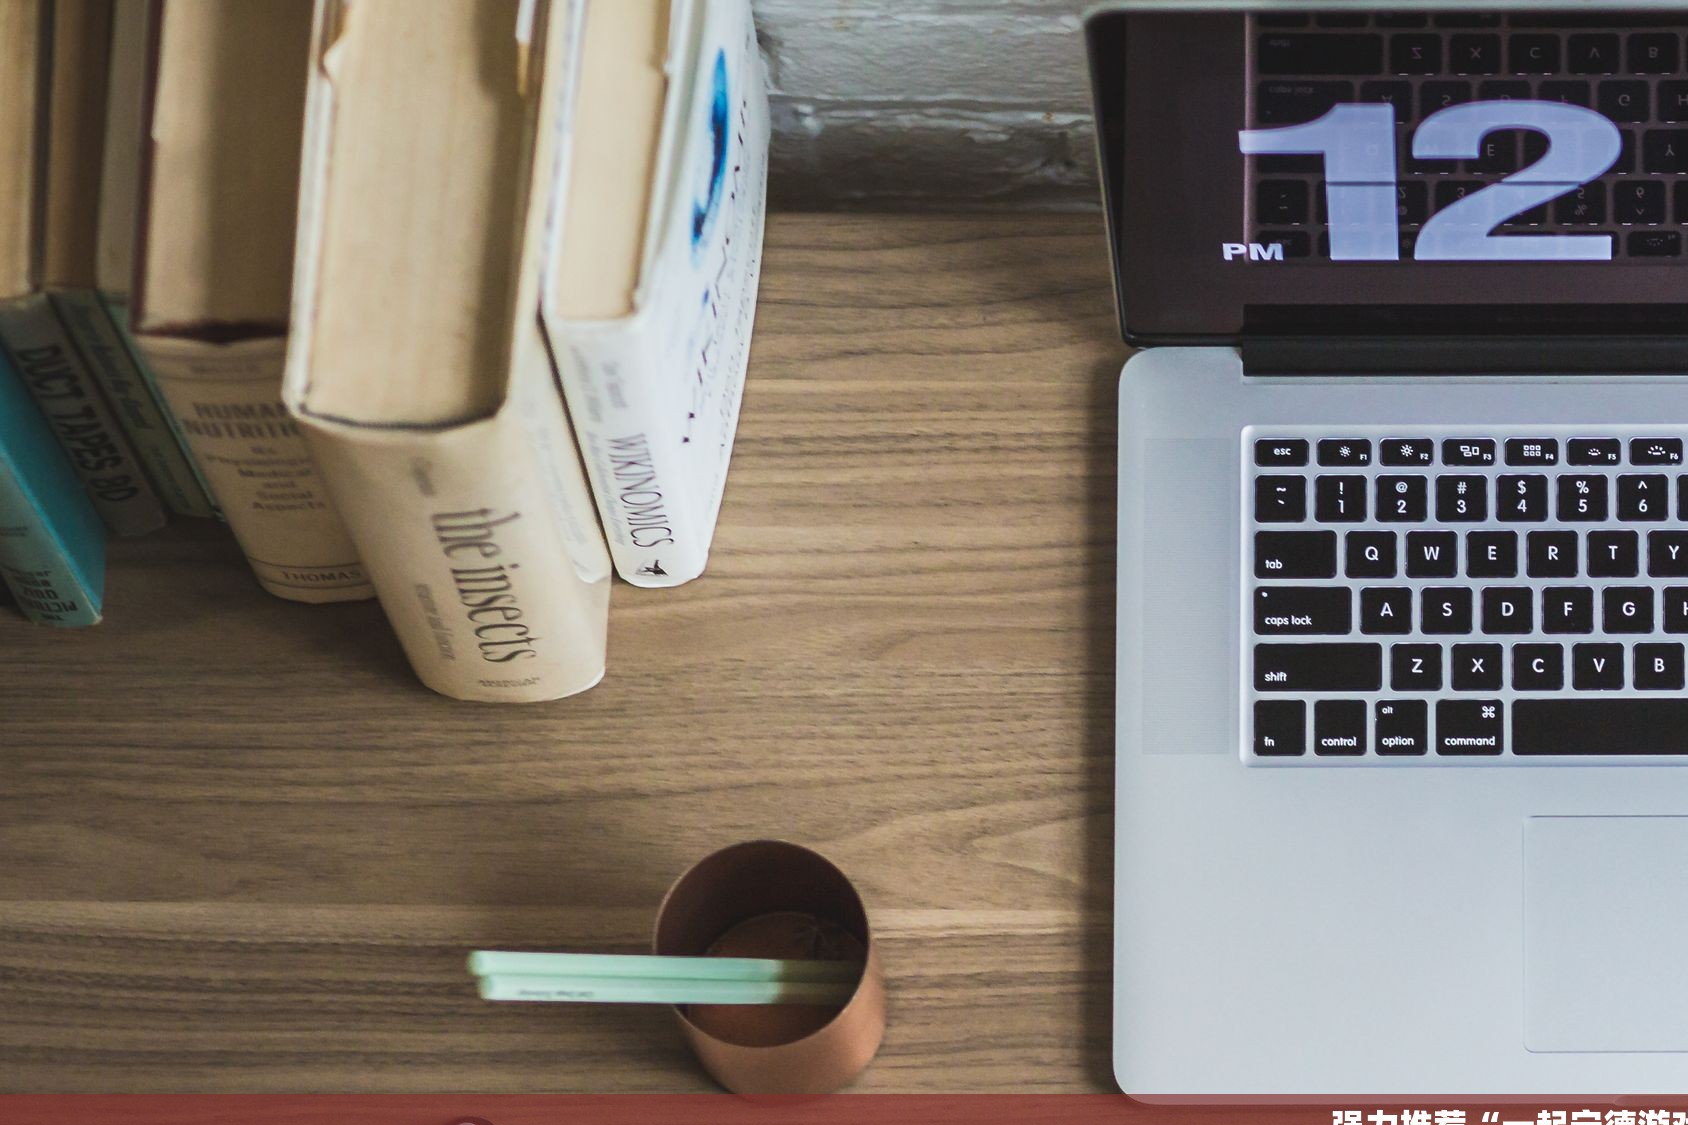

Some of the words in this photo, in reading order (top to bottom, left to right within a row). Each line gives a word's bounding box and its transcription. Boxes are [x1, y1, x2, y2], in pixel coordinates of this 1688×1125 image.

[1238, 99, 1623, 261] 12
[1221, 241, 1285, 262] PM
[1273, 447, 1292, 456] esc
[1359, 453, 1368, 461] F1
[1483, 453, 1492, 461] F3
[1607, 453, 1617, 461] F5
[1669, 452, 1679, 460] F6
[608, 432, 674, 549] WIKINOMICS
[1337, 499, 1344, 514] 1
[1397, 499, 1407, 514] 2
[1456, 499, 1467, 514] 3
[1516, 498, 1527, 513] 4
[1578, 498, 1588, 513] 5
[1638, 498, 1648, 513] 6
[432, 507, 521, 561] the
[1264, 558, 1283, 569] tab
[1364, 545, 1379, 561] Q
[1423, 546, 1440, 561] W
[1487, 545, 1497, 561] E
[1548, 545, 1559, 561] R
[1608, 545, 1619, 560] T
[1668, 545, 1680, 560] Y
[282, 568, 363, 584] THOMAS
[450, 561, 543, 664] insects
[1264, 617, 1290, 627] caps
[1291, 615, 1313, 626] lock
[1380, 602, 1394, 617] A
[1442, 602, 1453, 617] S
[1501, 601, 1514, 617] D
[1563, 601, 1573, 617] F
[1622, 601, 1636, 617] G
[1264, 671, 1288, 682] shift
[1411, 658, 1424, 674] Z
[1471, 658, 1485, 673] X
[1532, 658, 1545, 673] C
[1592, 657, 1606, 673] V
[1654, 657, 1665, 673] B
[1381, 705, 1394, 715] alt
[1263, 736, 1275, 747] fn
[1321, 736, 1357, 747] control
[1381, 735, 1415, 748] option
[1444, 735, 1496, 746] command
